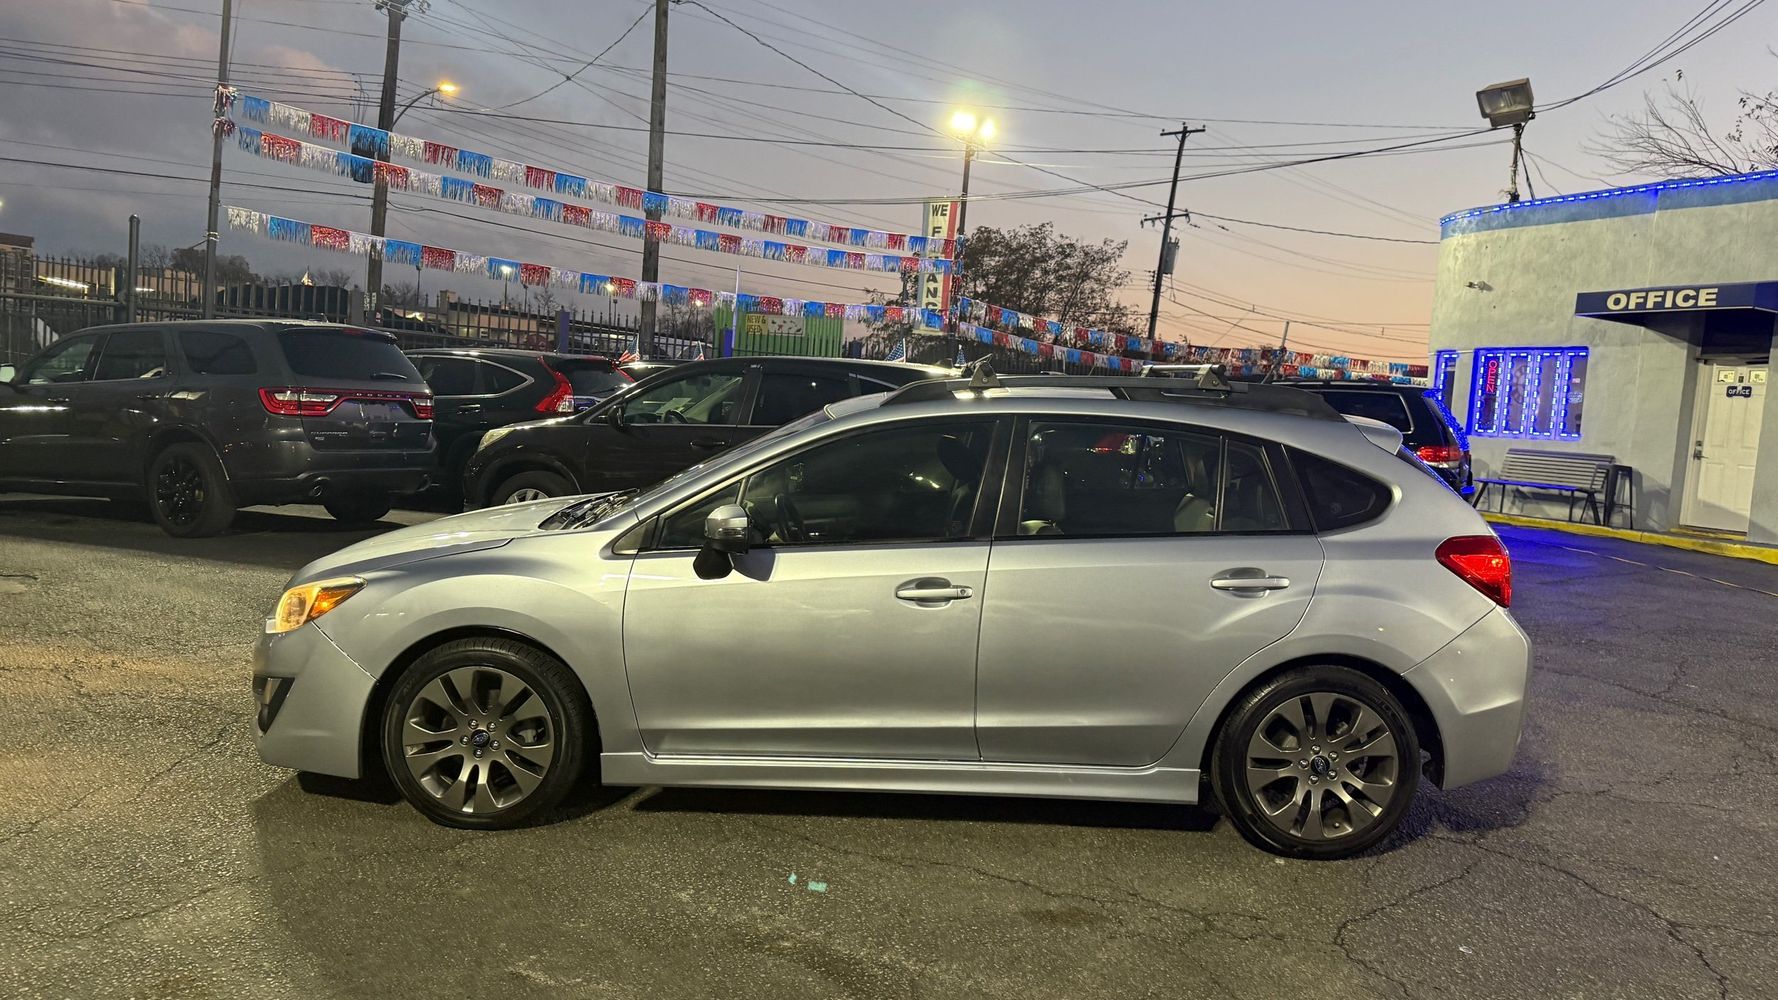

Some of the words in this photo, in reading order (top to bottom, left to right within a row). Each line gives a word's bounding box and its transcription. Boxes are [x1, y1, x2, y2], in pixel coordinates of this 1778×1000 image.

[932, 204, 948, 216] WE
[1606, 288, 1718, 311] OFFICE
[1487, 360, 1498, 393] OPEN
